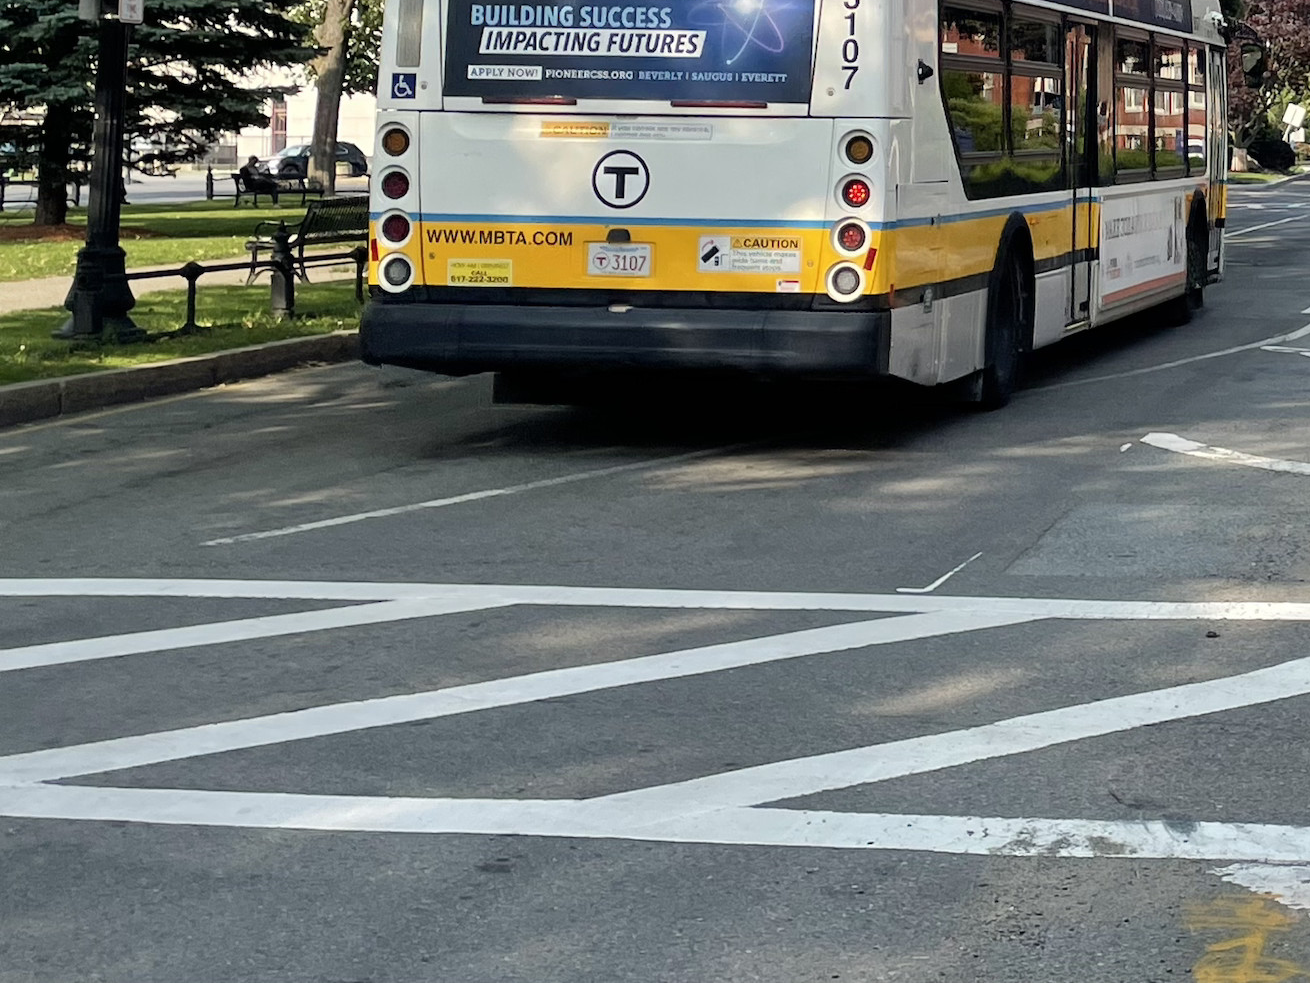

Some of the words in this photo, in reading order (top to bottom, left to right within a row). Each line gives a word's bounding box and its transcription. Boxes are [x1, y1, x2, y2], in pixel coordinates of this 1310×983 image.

[470, 4, 574, 27] BUILDING
[579, 5, 672, 28] SUCCESS
[485, 30, 601, 52] IMPACTING
[606, 32, 700, 54] FUTURES
[470, 67, 504, 78] APPLY
[507, 67, 538, 78] NOW!
[545, 69, 634, 81] PIONEERCSS.ORG
[638, 71, 683, 81] BEVERLY
[691, 72, 733, 82] SAUGUS
[741, 73, 788, 83] EVERETT
[603, 166, 639, 199] T
[427, 228, 573, 246] WWW.MBTA.COM
[743, 238, 799, 249] CAUTION
[595, 256, 607, 267] T
[611, 254, 647, 271] 3107
